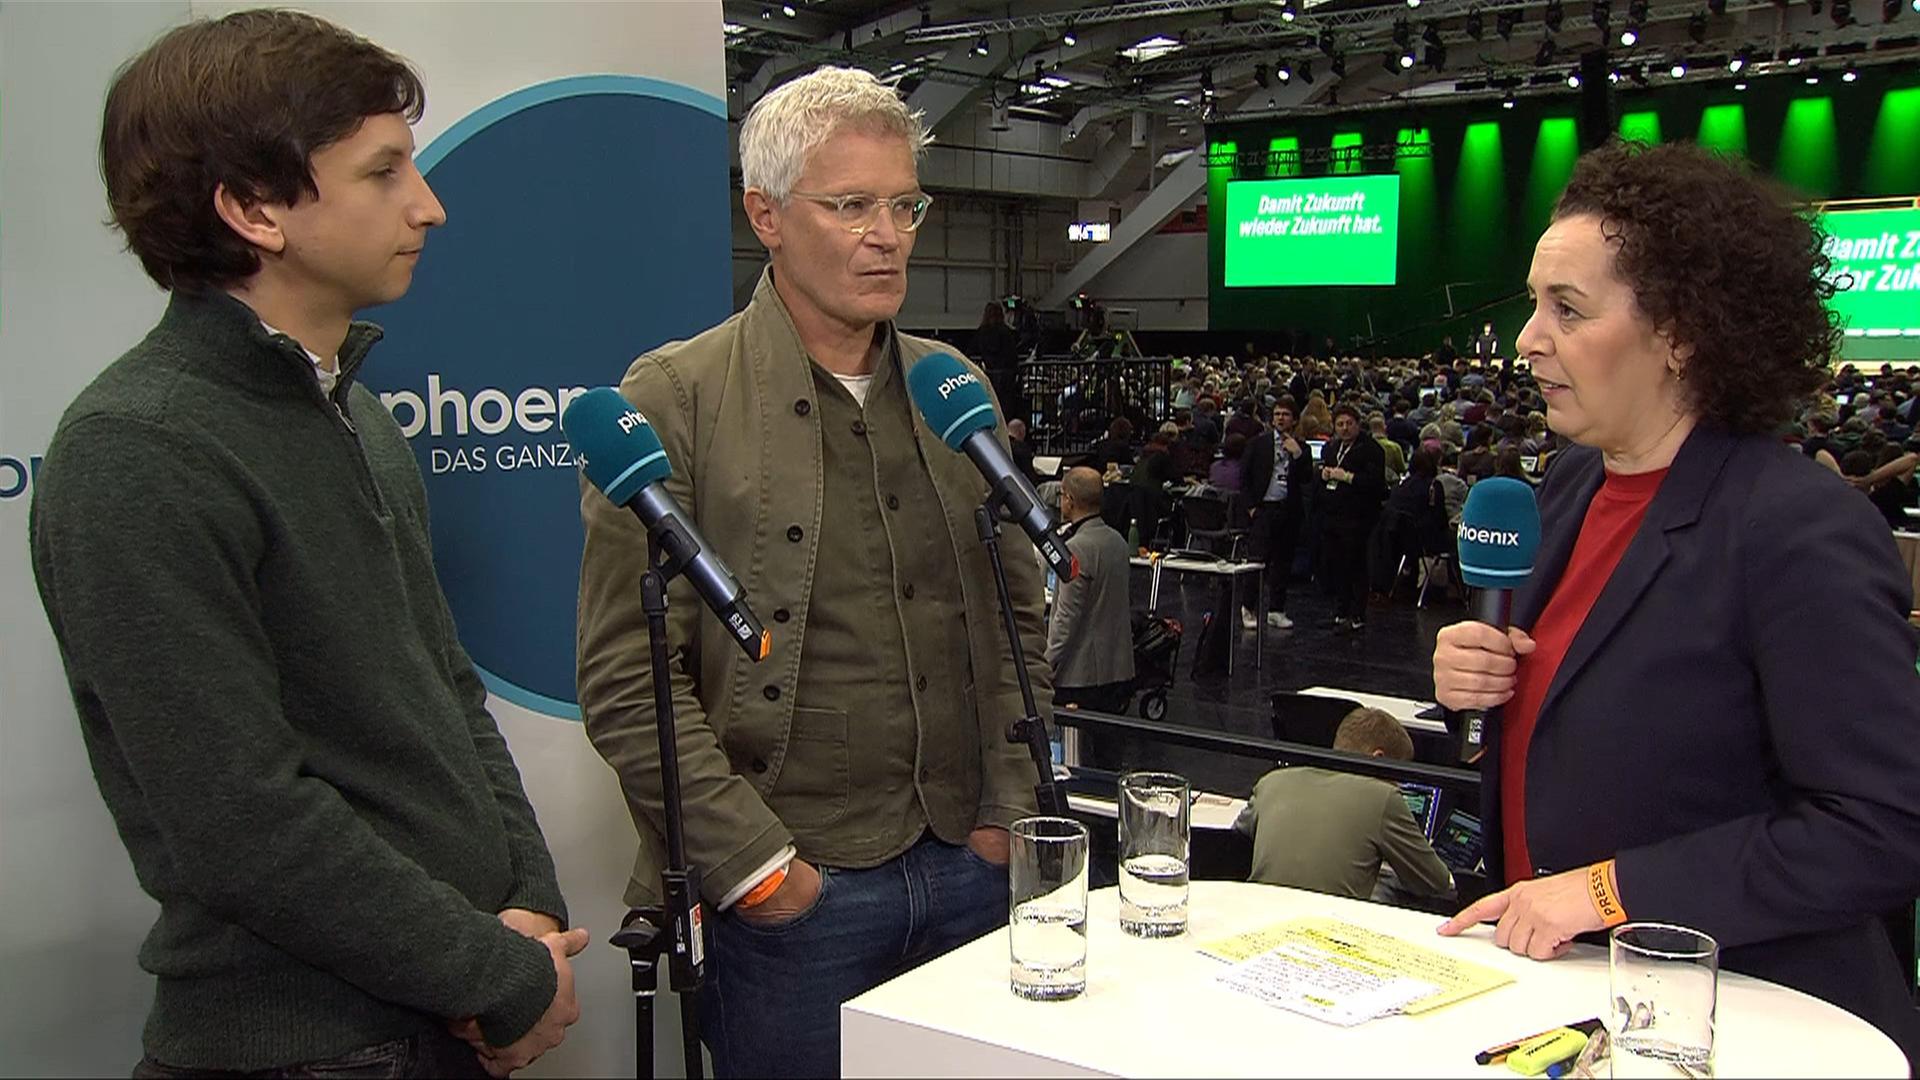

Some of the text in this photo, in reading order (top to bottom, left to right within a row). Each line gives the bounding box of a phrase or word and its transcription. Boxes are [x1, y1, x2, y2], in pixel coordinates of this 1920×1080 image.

[1258, 191, 1365, 214] Damit Zukunft
[1239, 214, 1382, 237] wieder Zukunft hat.
[432, 447, 486, 473] DAS
[496, 444, 577, 470] GANZ
[1592, 868, 1616, 916] PRESSE
